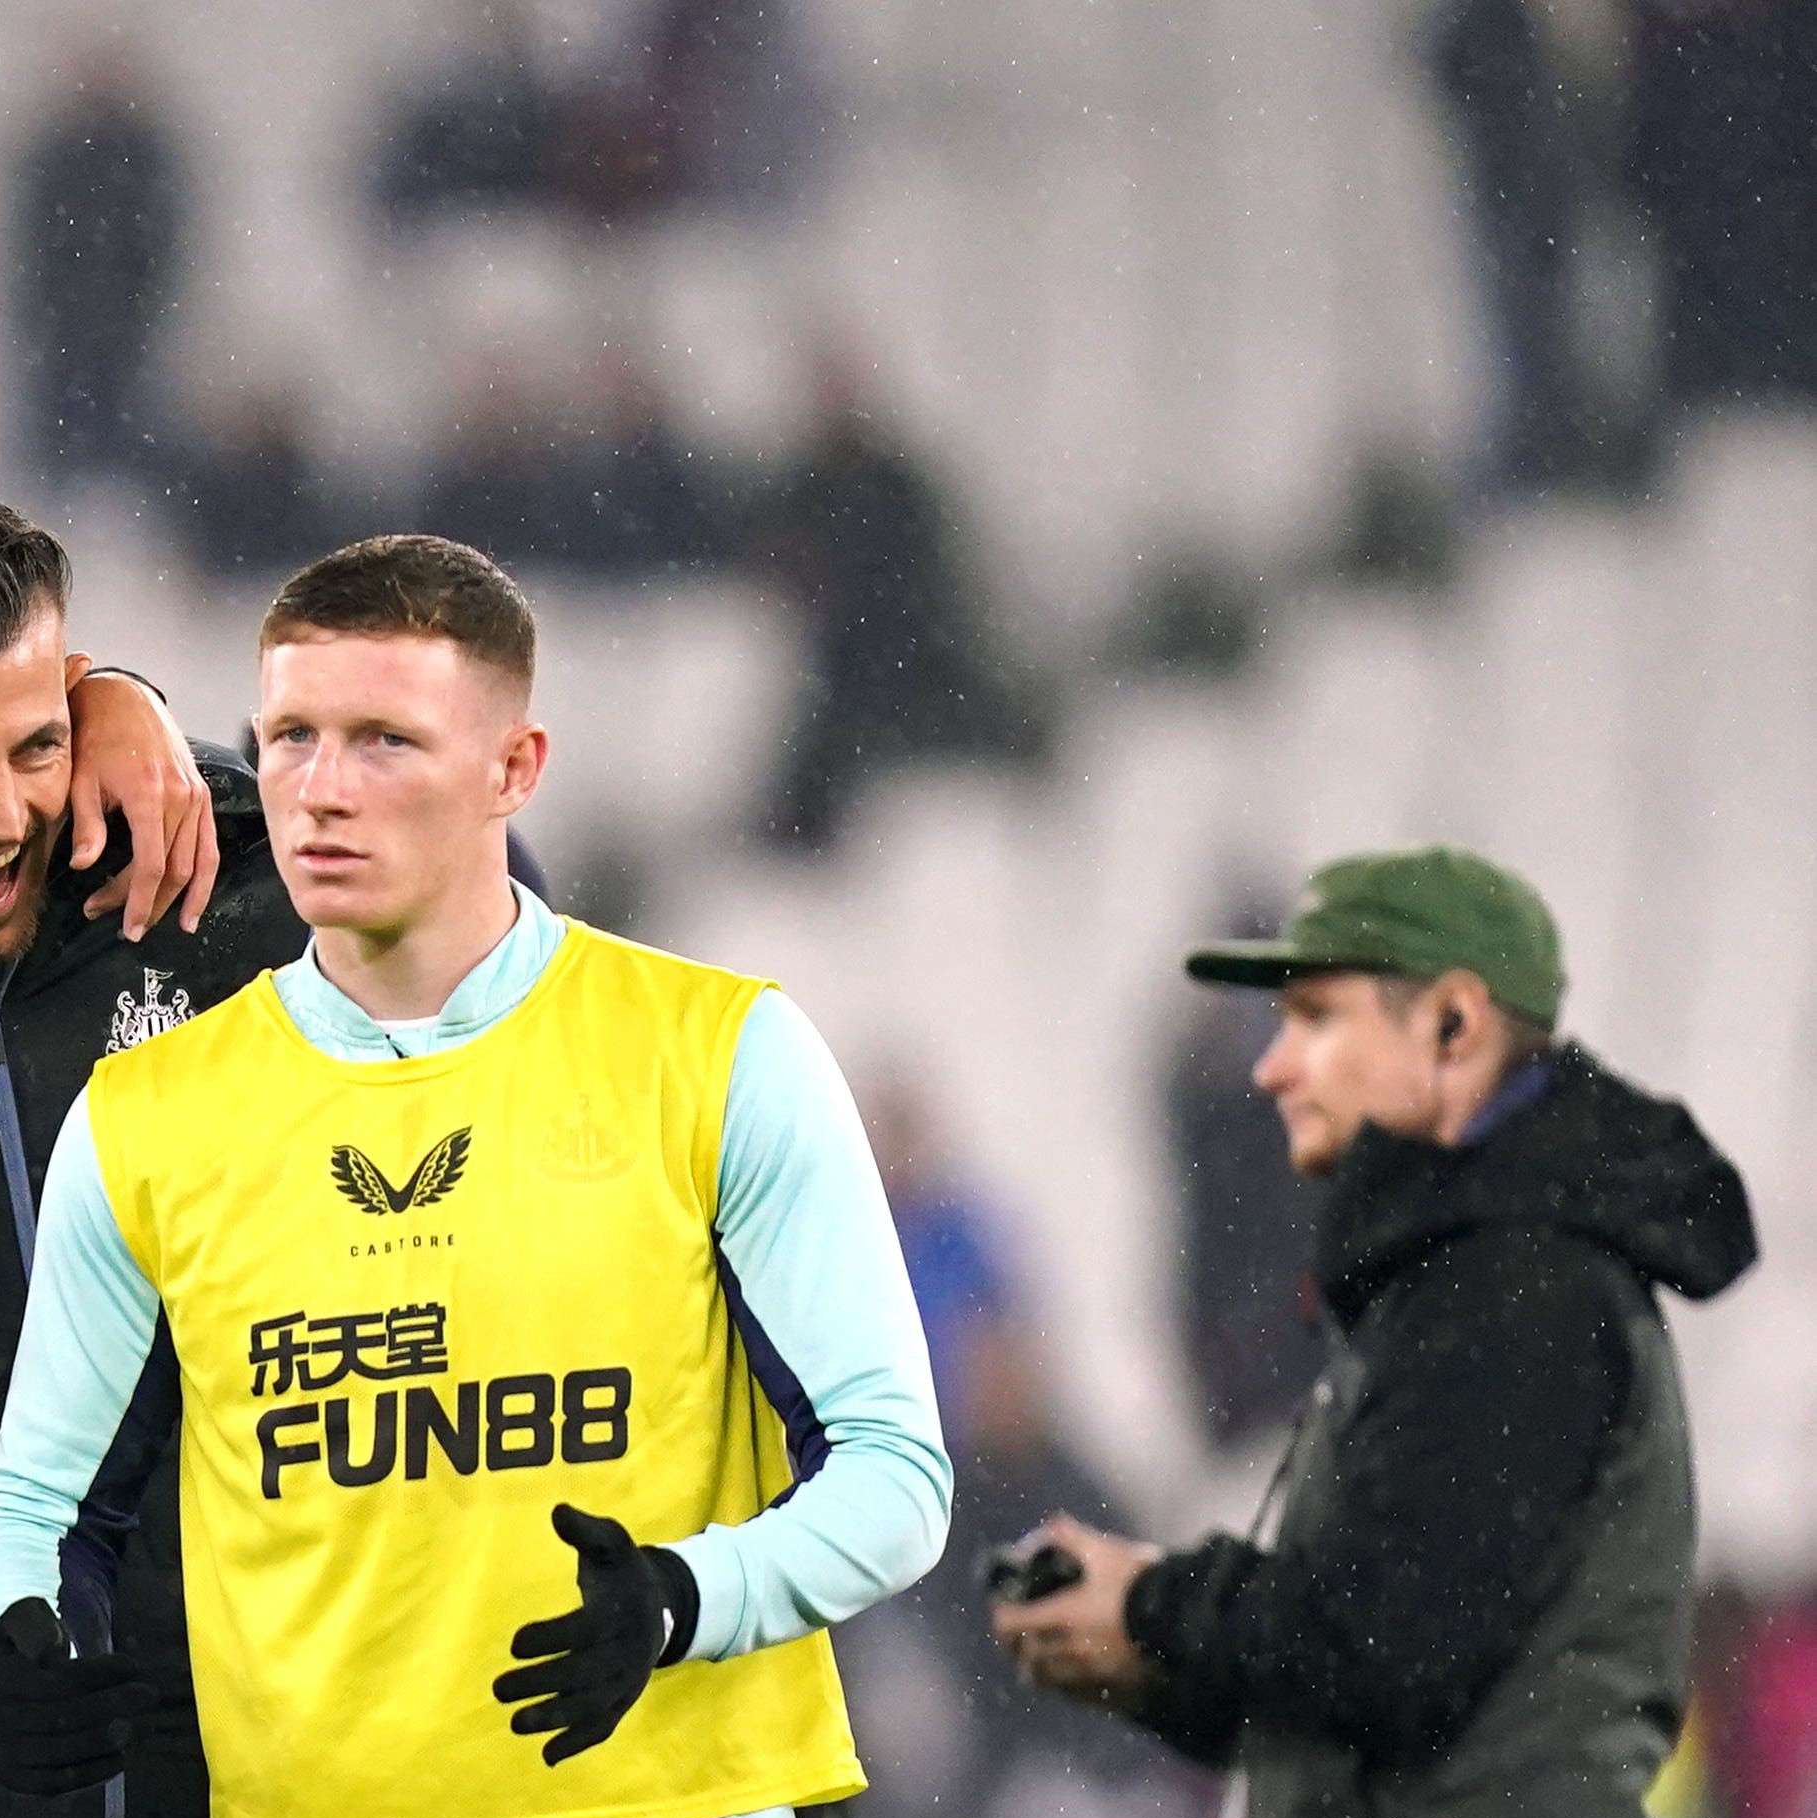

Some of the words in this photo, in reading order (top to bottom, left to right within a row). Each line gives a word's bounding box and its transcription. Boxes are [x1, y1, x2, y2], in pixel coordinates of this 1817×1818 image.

[350, 1234, 454, 1258] CASTORE
[249, 1301, 448, 1397] 乐天堂
[256, 1366, 632, 1500] FUN88
